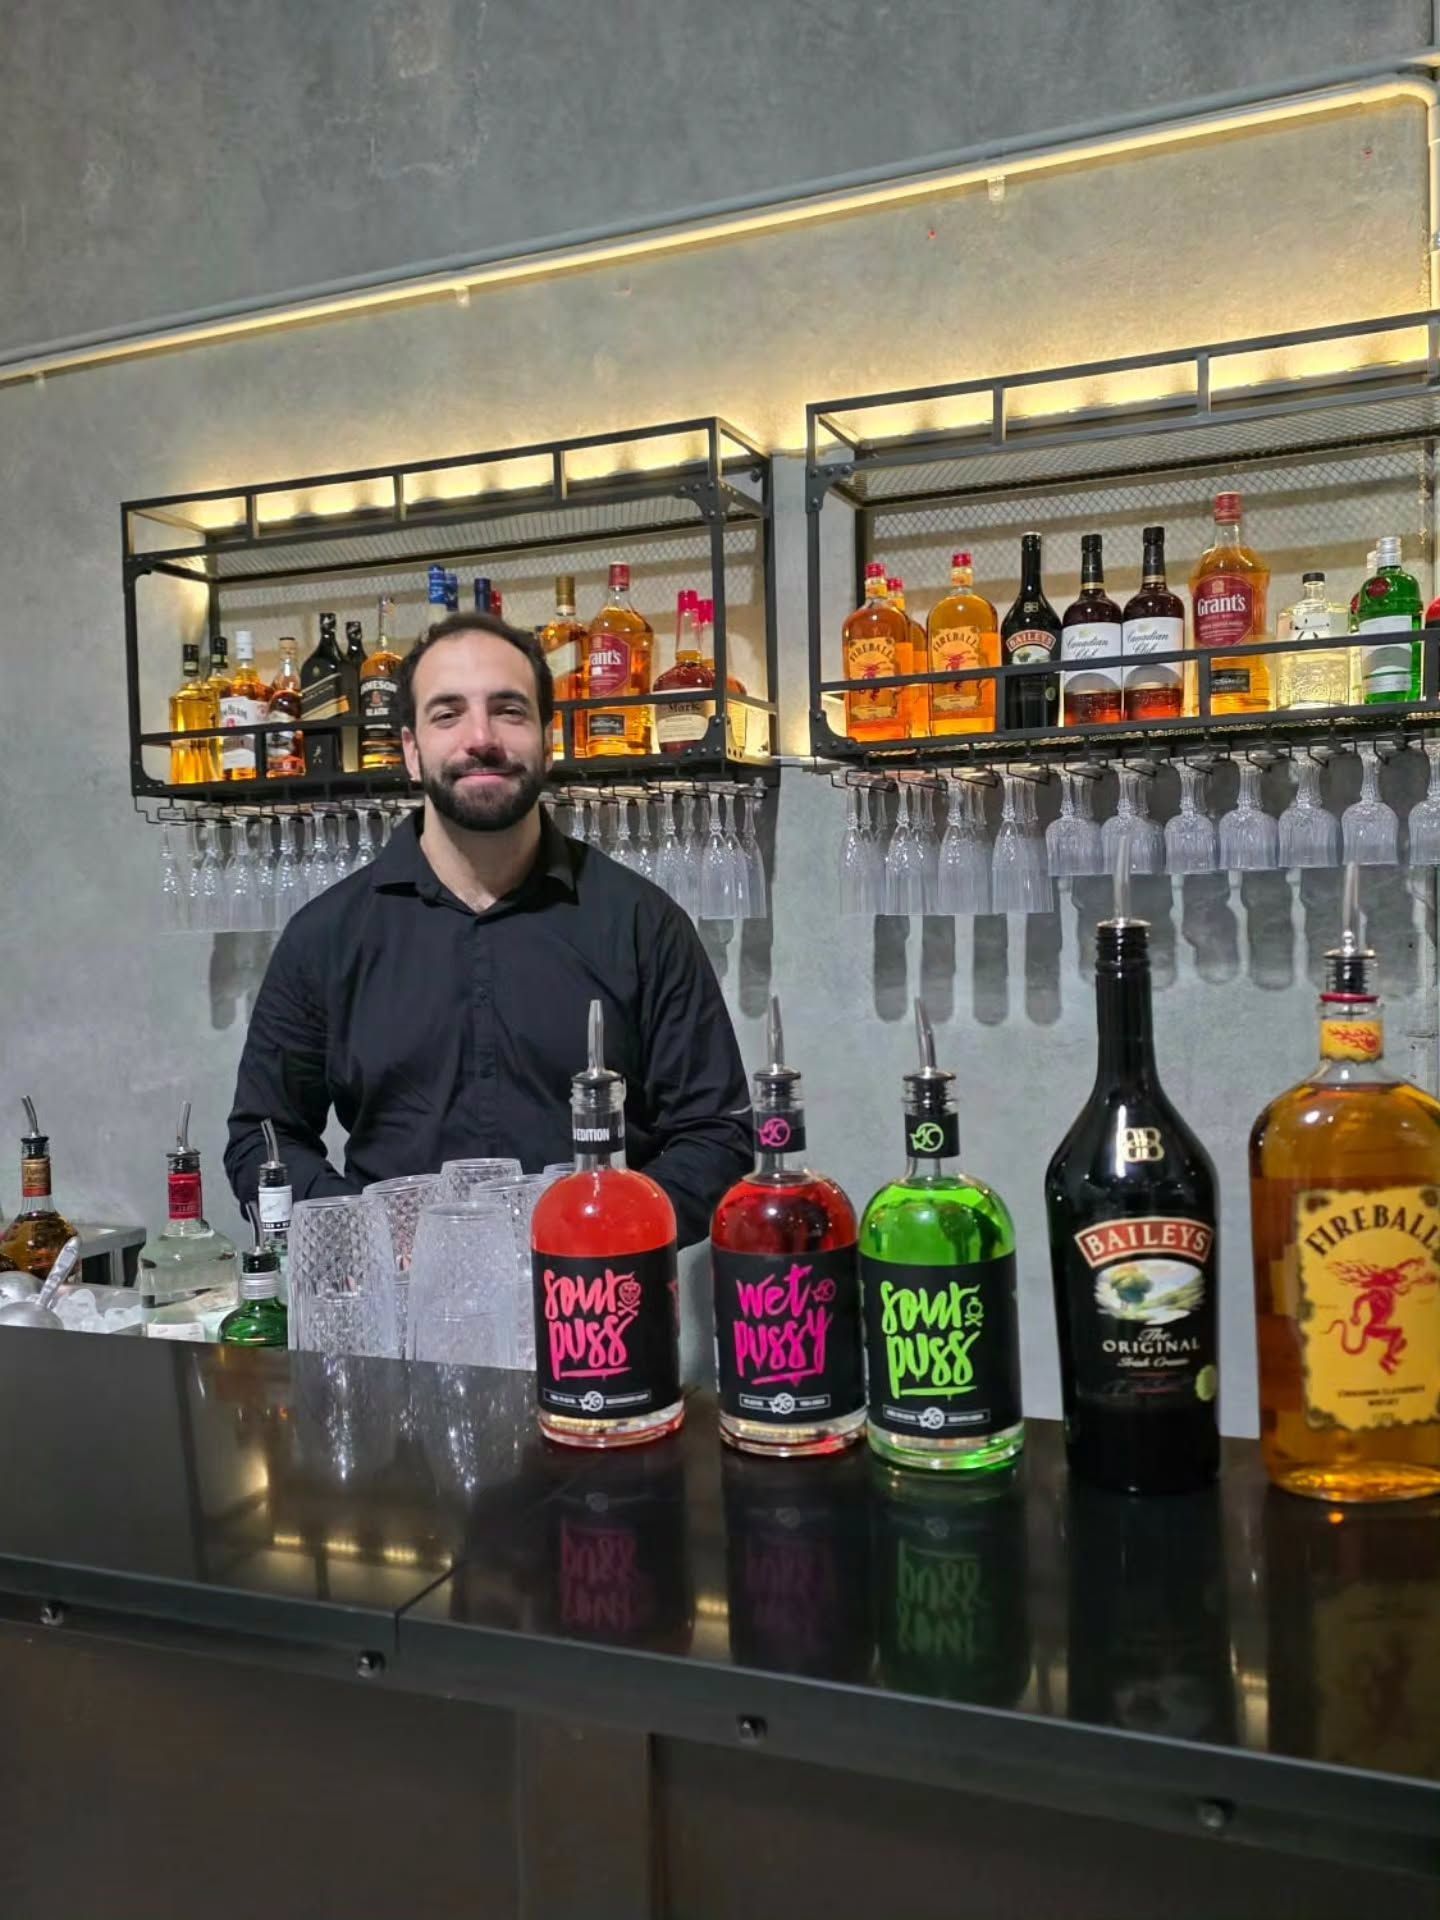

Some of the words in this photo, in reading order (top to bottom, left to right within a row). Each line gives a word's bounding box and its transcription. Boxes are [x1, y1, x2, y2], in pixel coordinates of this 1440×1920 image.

[1197, 594, 1246, 616] Grant's
[588, 650, 622, 665] ant's
[935, 630, 977, 653] FIREBALL
[1084, 1223, 1208, 1257] BAILEYS
[1304, 1203, 1438, 1257] FIREBALL
[543, 1268, 636, 1319] sour
[880, 1280, 981, 1335] sour
[548, 1314, 635, 1382] puss
[1101, 1337, 1201, 1354] ORIGINAL
[1138, 1327, 1172, 1341] The
[886, 1329, 981, 1400] puss
